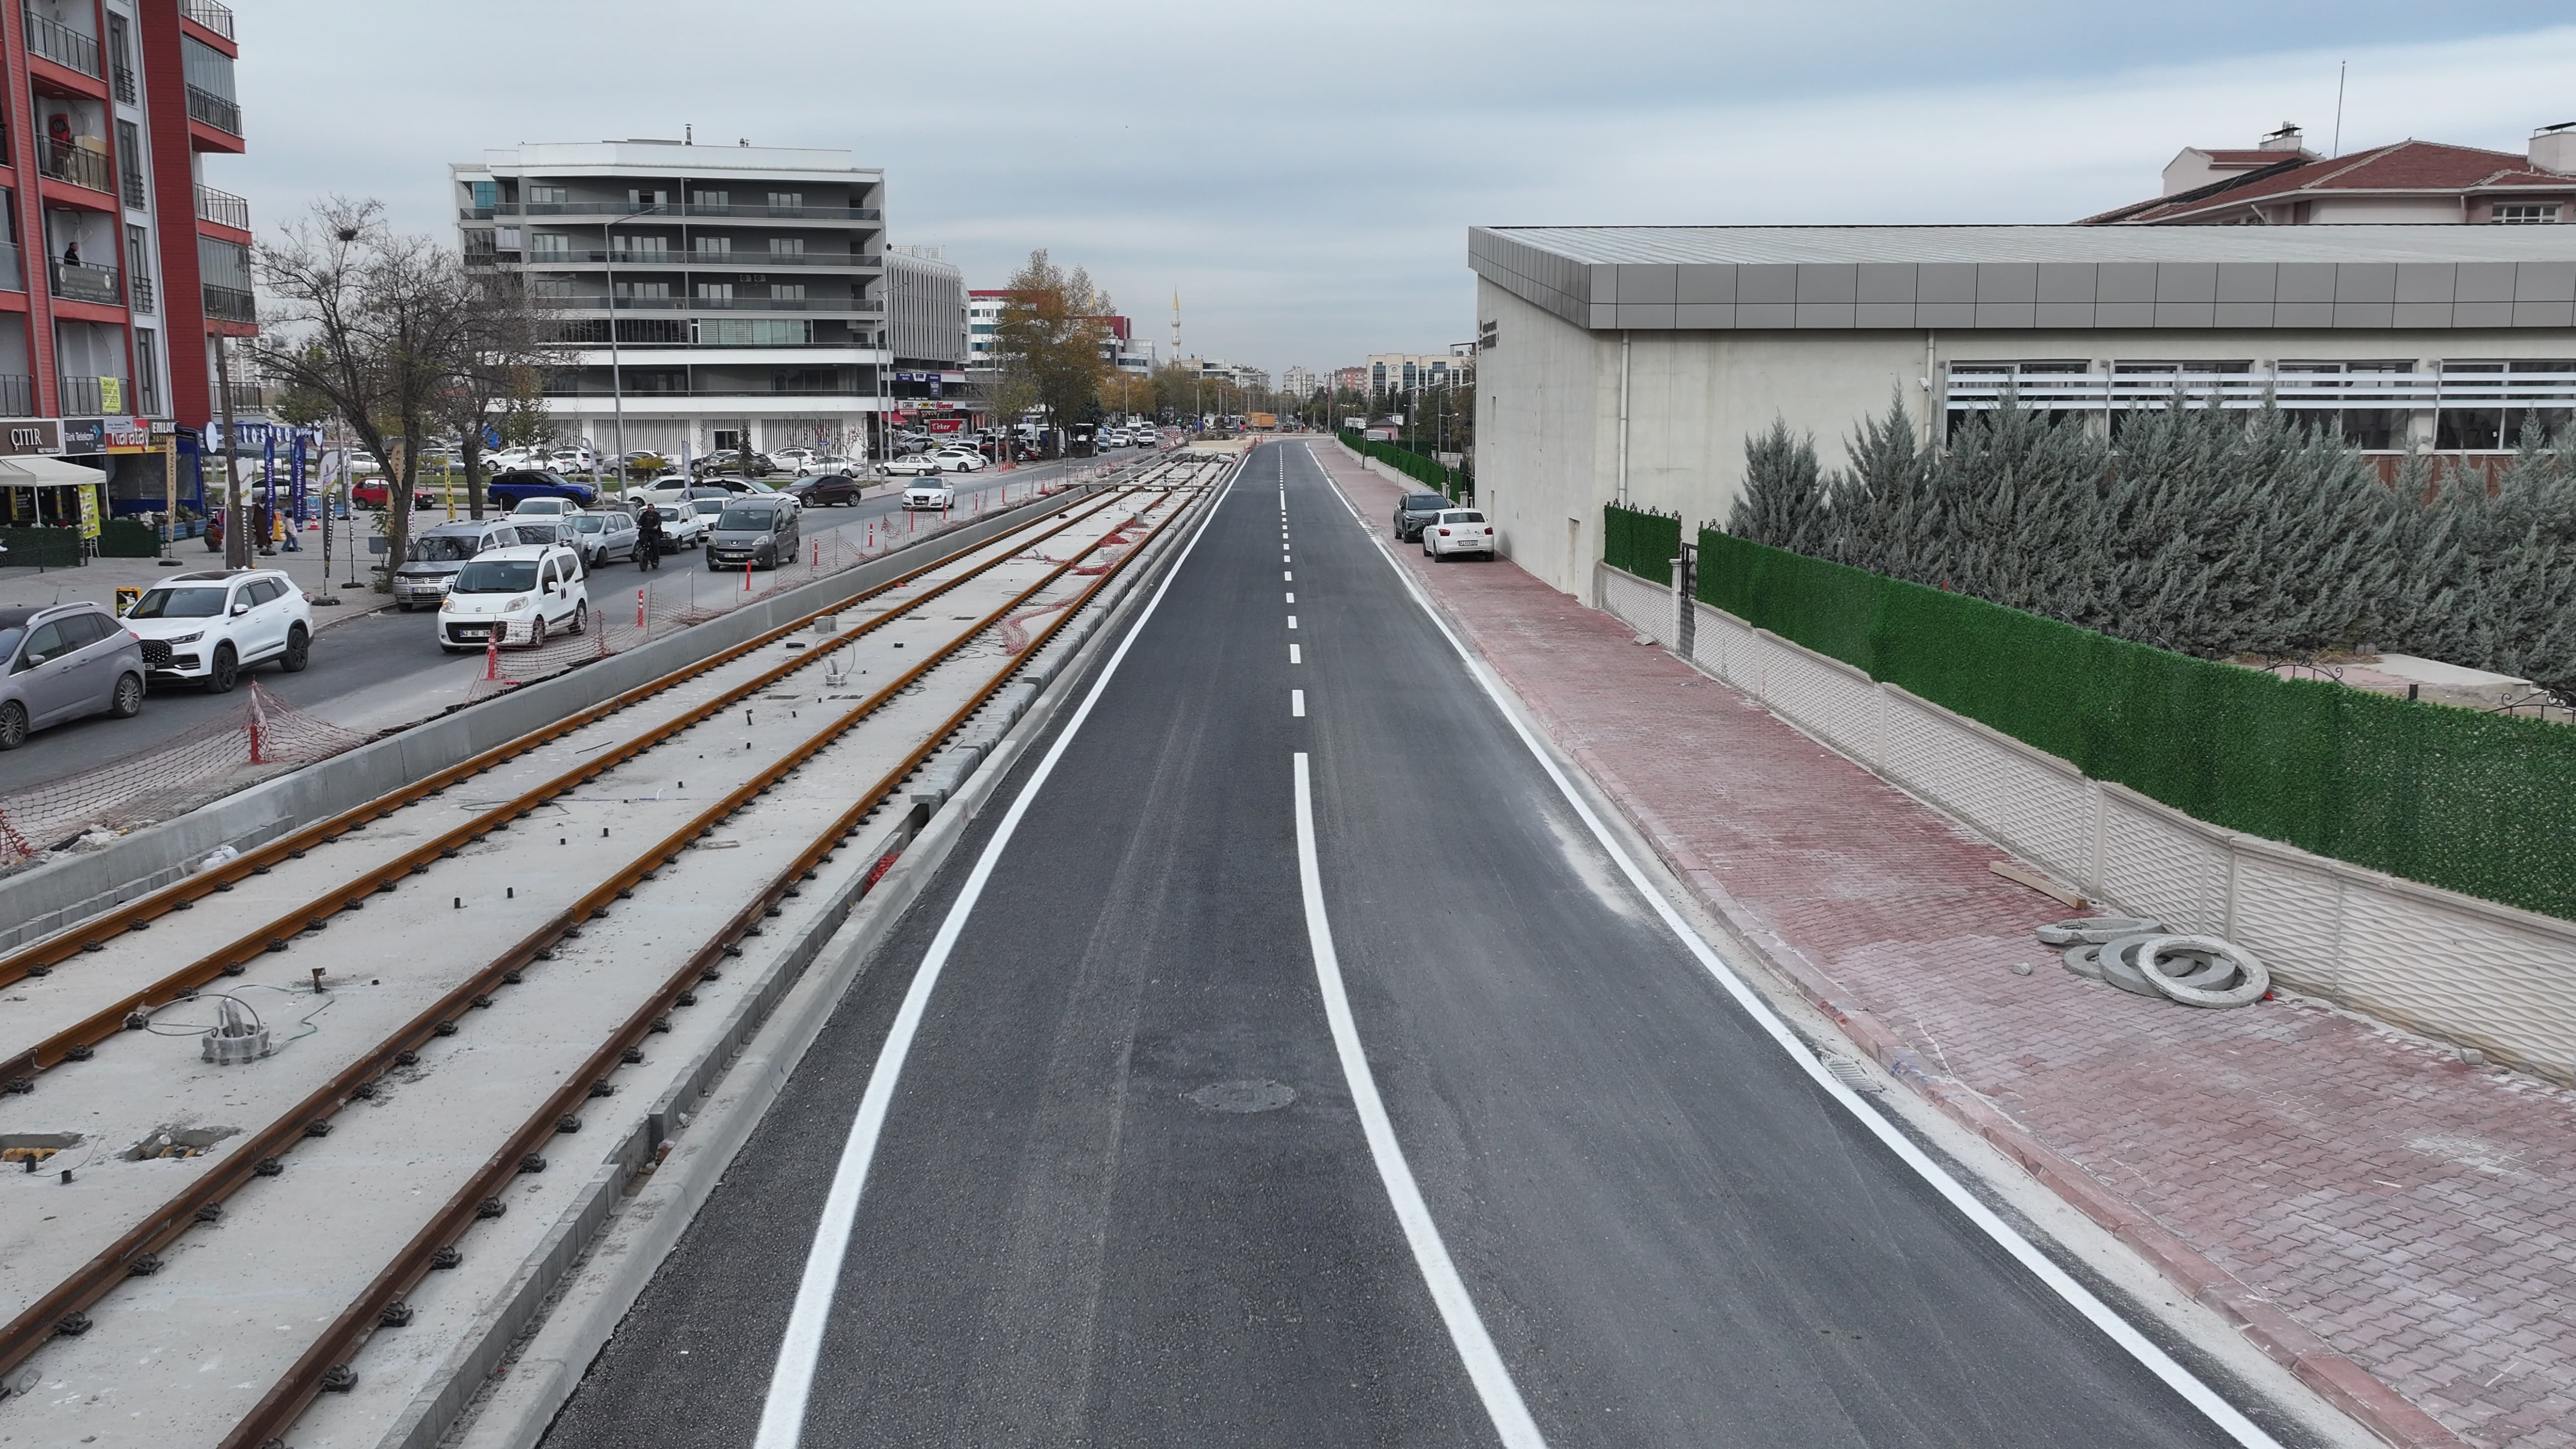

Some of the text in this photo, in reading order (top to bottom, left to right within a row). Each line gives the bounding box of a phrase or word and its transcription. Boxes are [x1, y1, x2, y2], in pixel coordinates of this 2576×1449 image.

[153, 422, 176, 433] EMLAK
[11, 428, 43, 450] ÇITIR
[65, 432, 94, 441] Türk Telekom
